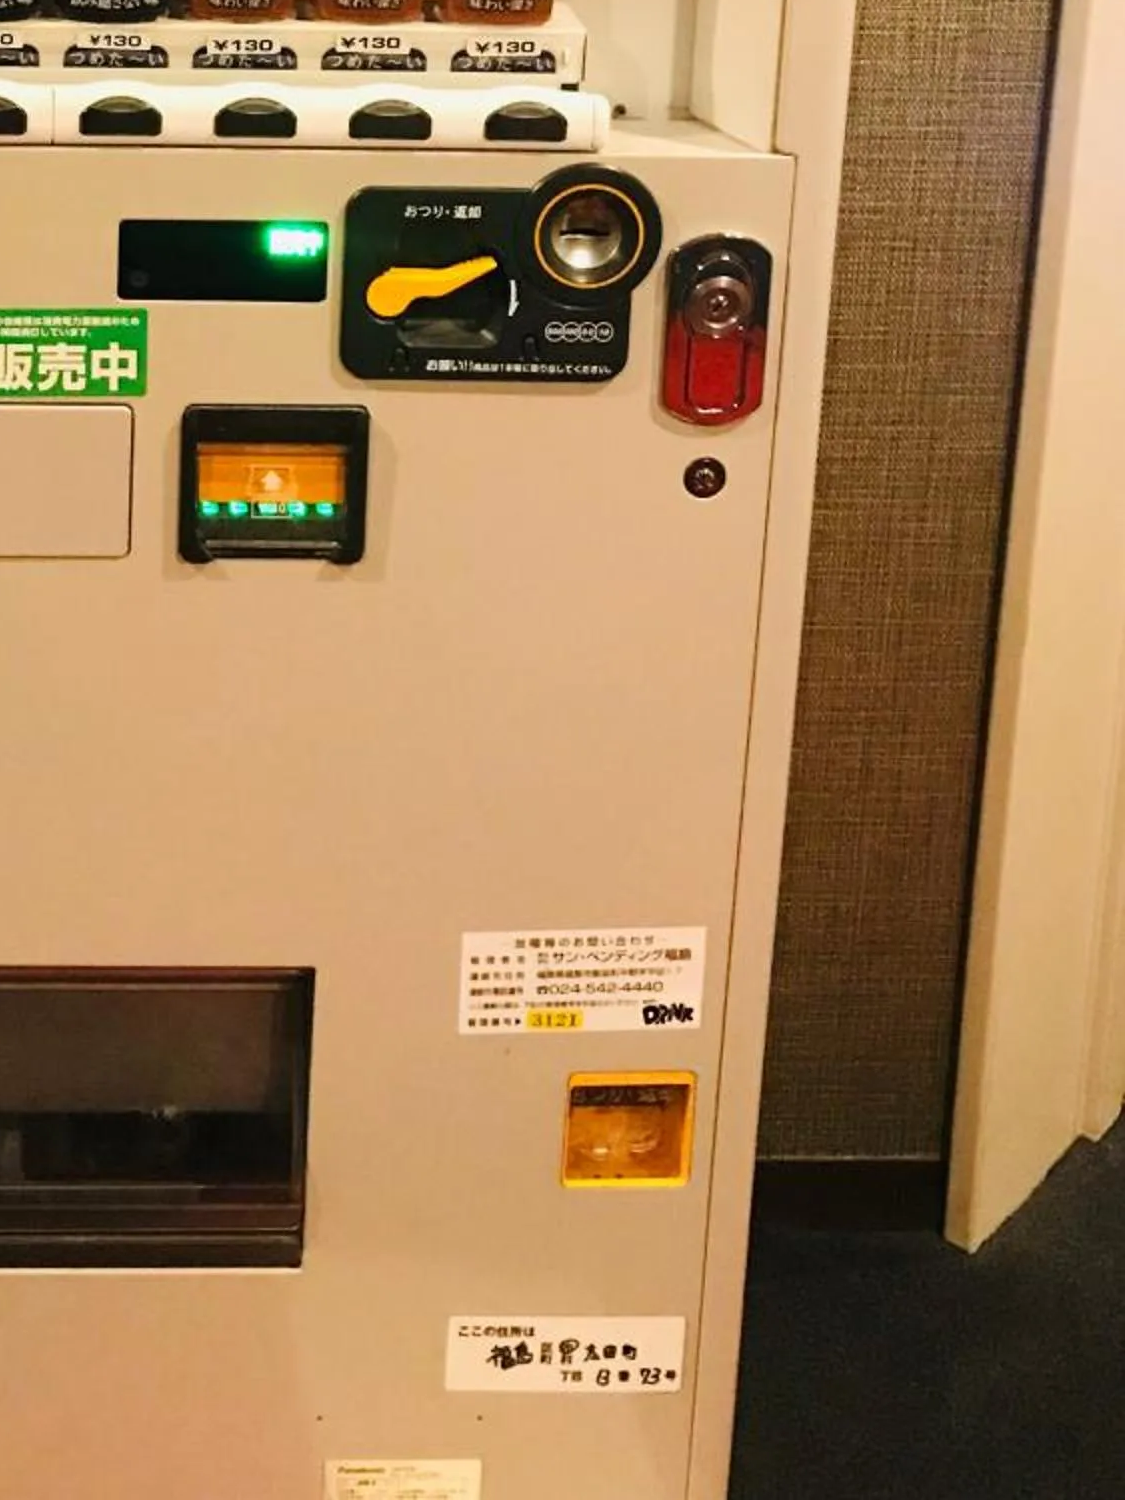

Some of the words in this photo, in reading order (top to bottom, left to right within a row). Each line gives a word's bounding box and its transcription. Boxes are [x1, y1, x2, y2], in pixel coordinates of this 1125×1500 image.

[91, 35, 141, 46] ¥130
[213, 39, 273, 51] ¥130
[341, 37, 400, 49] ¥130
[475, 41, 534, 53] ¥130
[530, 1013, 578, 1027] 3121
